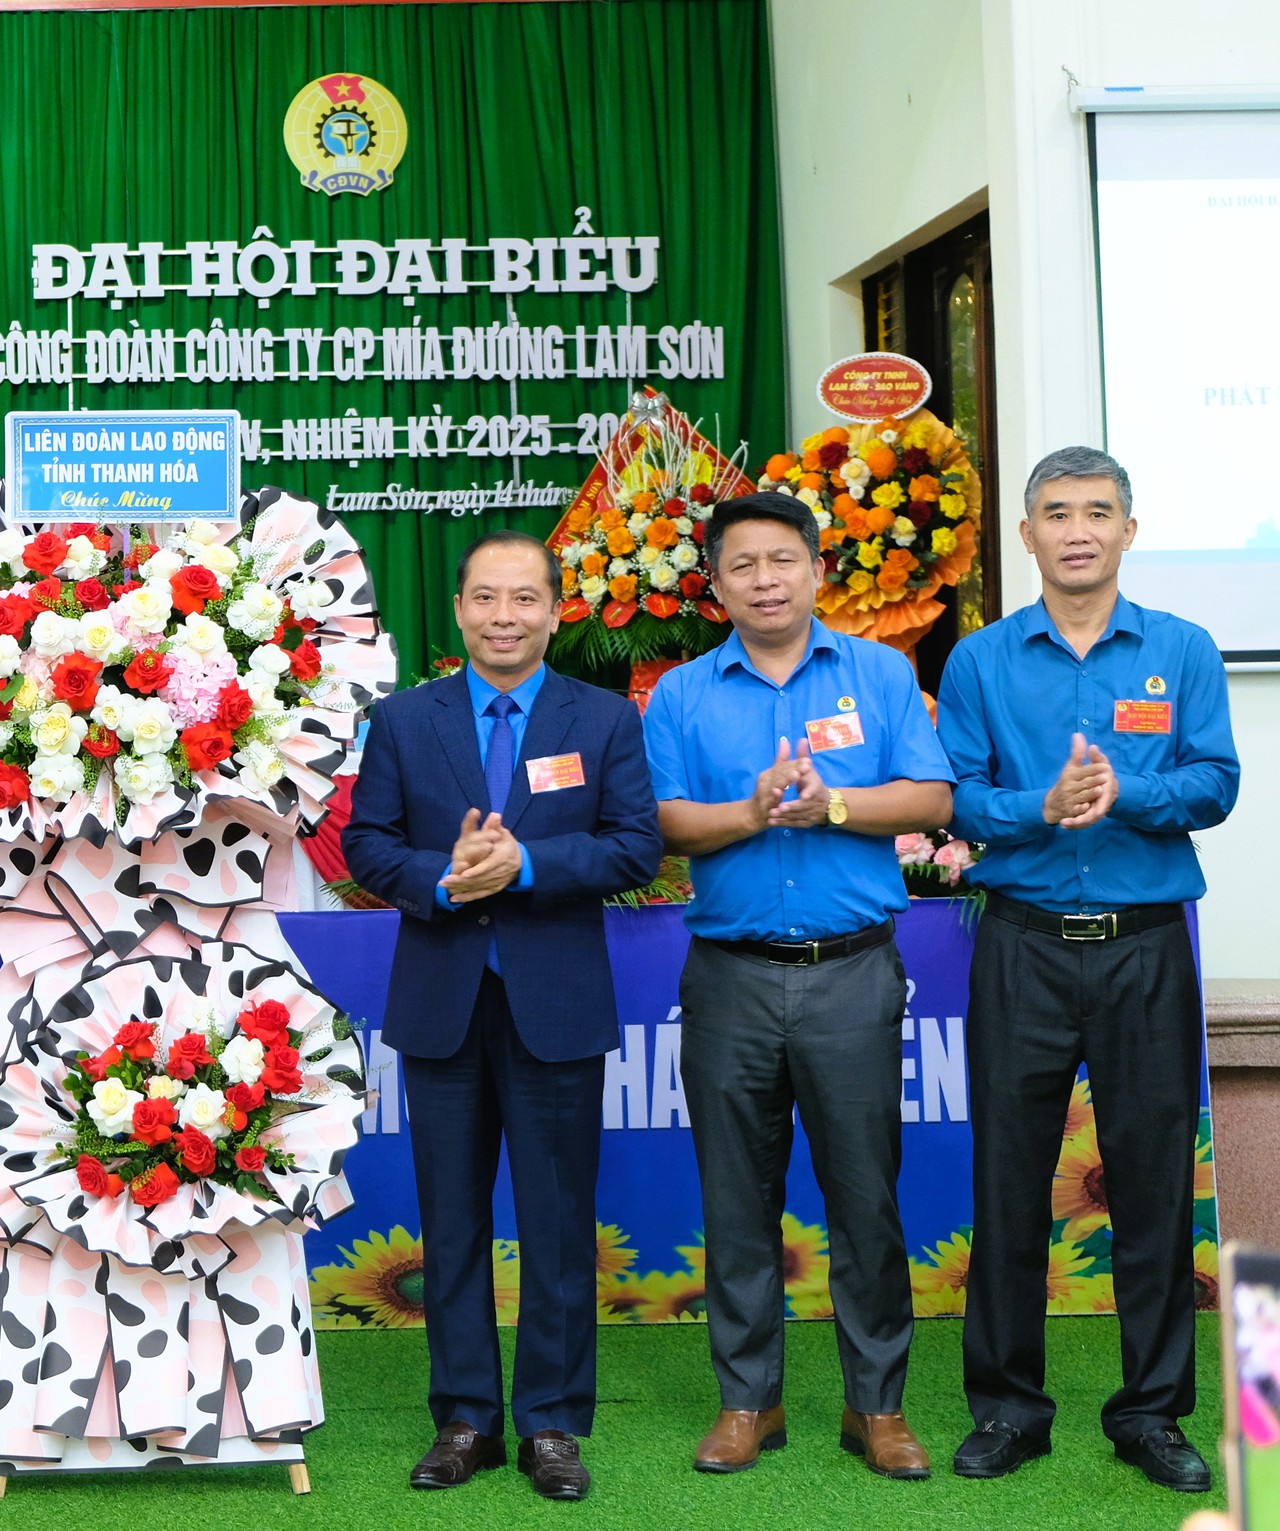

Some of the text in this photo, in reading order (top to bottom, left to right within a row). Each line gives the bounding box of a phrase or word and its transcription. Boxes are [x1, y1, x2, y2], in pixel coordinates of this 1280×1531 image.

[327, 174, 369, 190] CĐVN
[32, 206, 659, 310] ĐẠI HỘI ĐẠI BIỂU
[85, 319, 174, 384] ĐOÀN
[185, 318, 274, 383] CÔNG
[284, 328, 323, 381] TY
[333, 327, 374, 381] CP
[383, 315, 445, 380] MÍA
[452, 312, 565, 380] ĐƯỜNG
[575, 325, 647, 378] LAM
[658, 320, 724, 380] SƠN
[829, 383, 848, 391] LAM
[849, 382, 869, 391] SƠN
[875, 383, 893, 391] SAO
[872, 371, 882, 379] TY
[24, 427, 225, 455] LIÊN ĐOÀN LAO ĐỘNG
[283, 409, 395, 468] NHIỆM
[407, 404, 451, 458] KỲ
[467, 412, 550, 457] 2025
[577, 412, 628, 454] 20
[41, 456, 199, 483] TỈNH THANH HÓA
[61, 490, 173, 510] Chúc Mừng
[326, 484, 378, 511] Lam
[518, 479, 570, 507] thán
